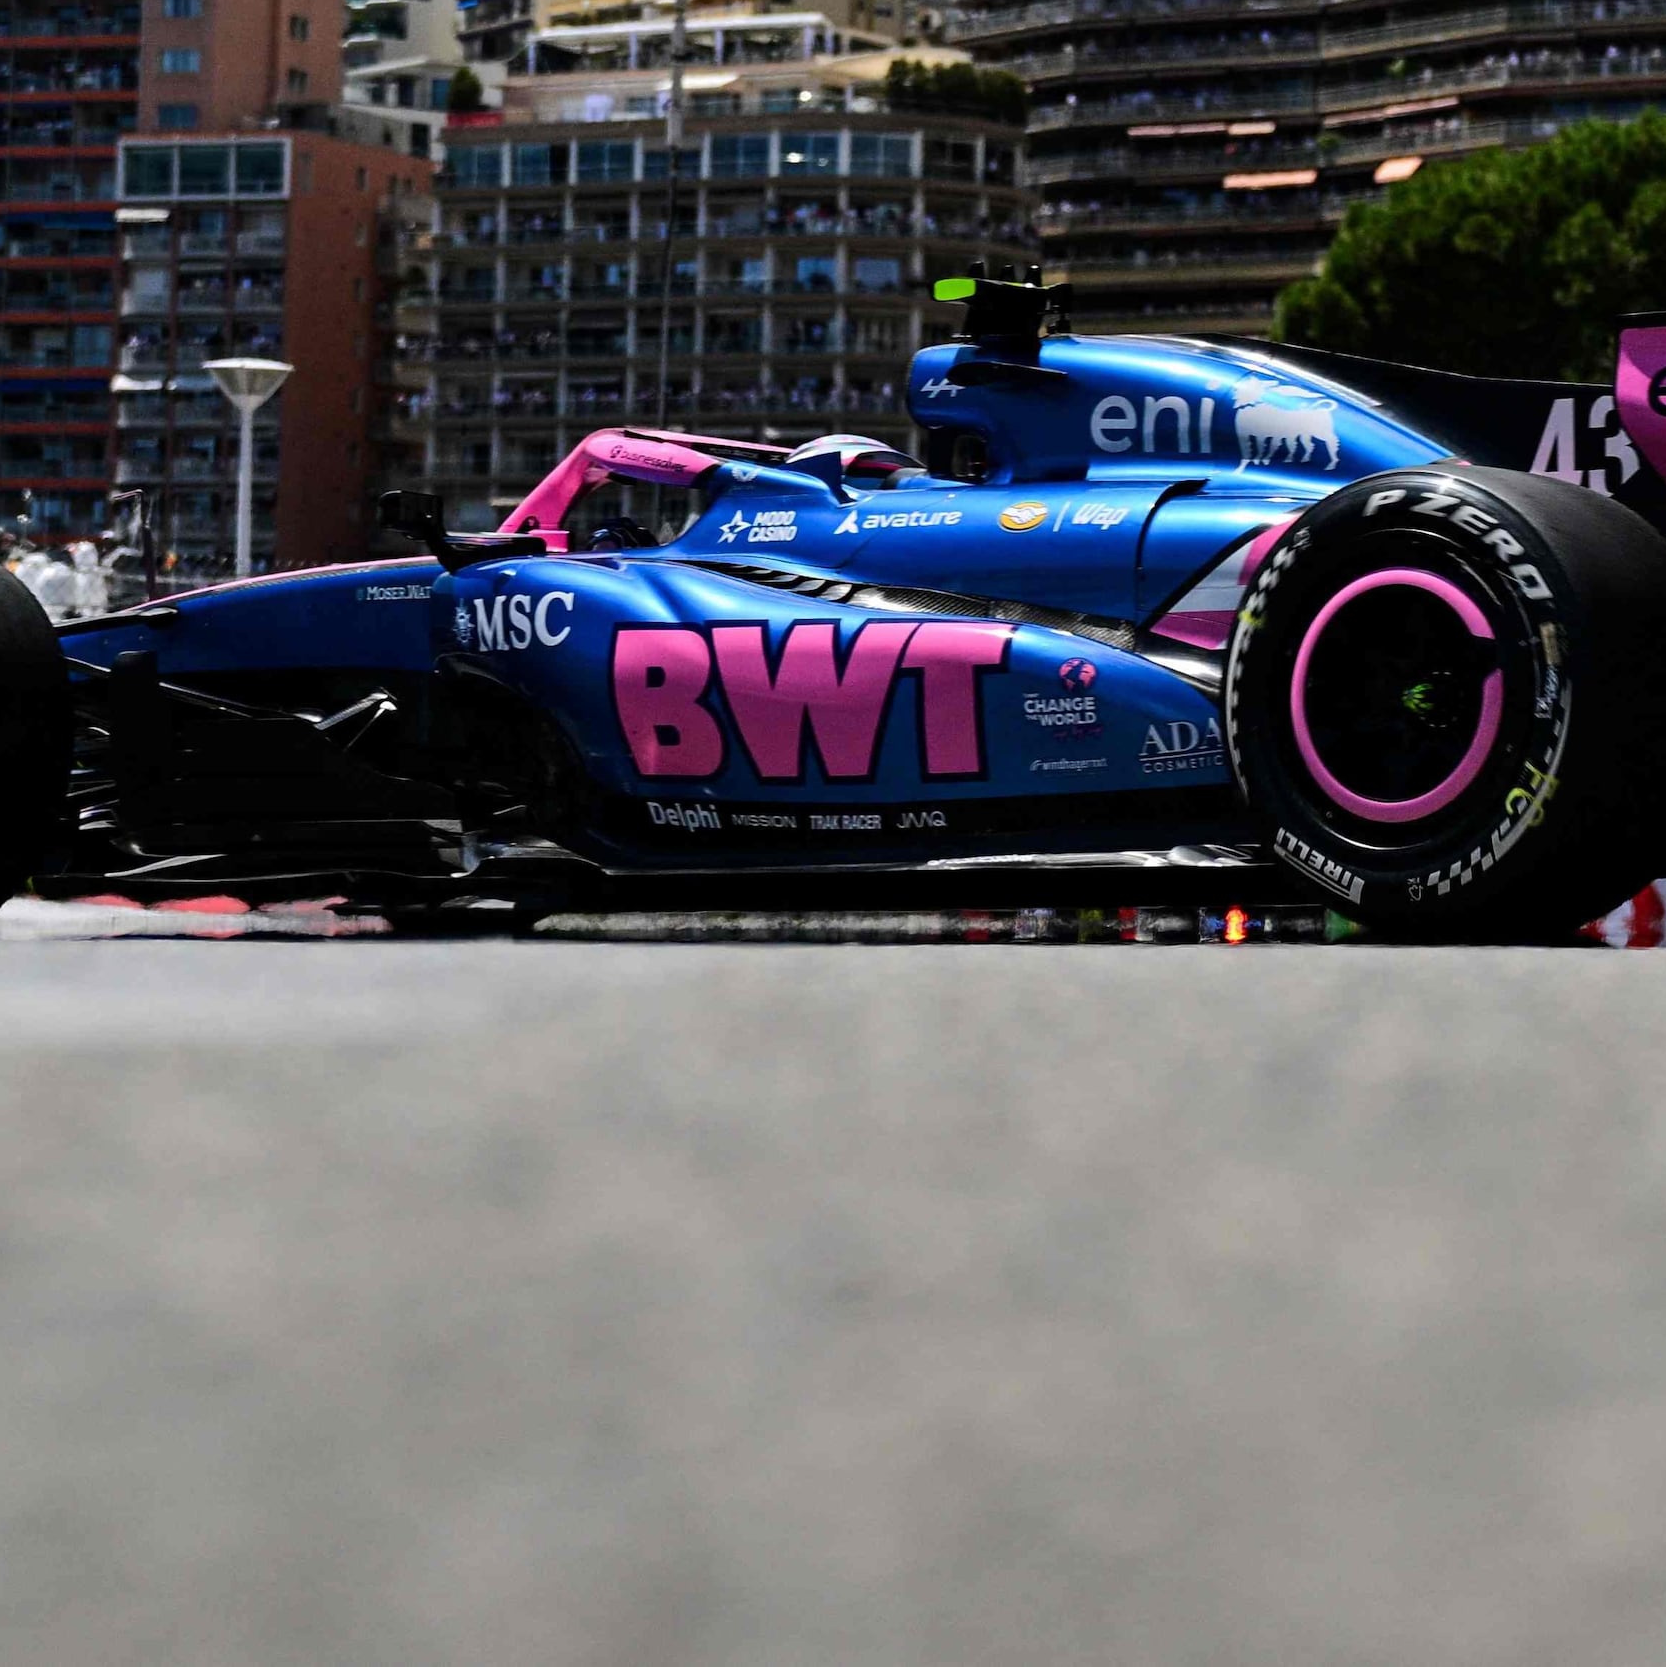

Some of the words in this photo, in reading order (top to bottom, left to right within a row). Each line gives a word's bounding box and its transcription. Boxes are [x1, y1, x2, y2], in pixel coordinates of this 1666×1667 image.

[1090, 379, 1221, 454] eni
[1529, 395, 1641, 498] 43
[753, 511, 796, 526] MODO
[862, 510, 962, 530] avature
[747, 525, 798, 542] CASINO
[1363, 489, 1407, 517] P
[1410, 492, 1554, 600] ZERO
[473, 591, 575, 652] MSC
[611, 621, 1018, 779] BWT
[1024, 697, 1096, 713] CHANGE
[1039, 712, 1097, 726] WORLD
[647, 801, 721, 832] Delphi
[732, 814, 797, 828] MISSION
[842, 815, 882, 830] RACER
[1274, 827, 1365, 905] PIRELLI
